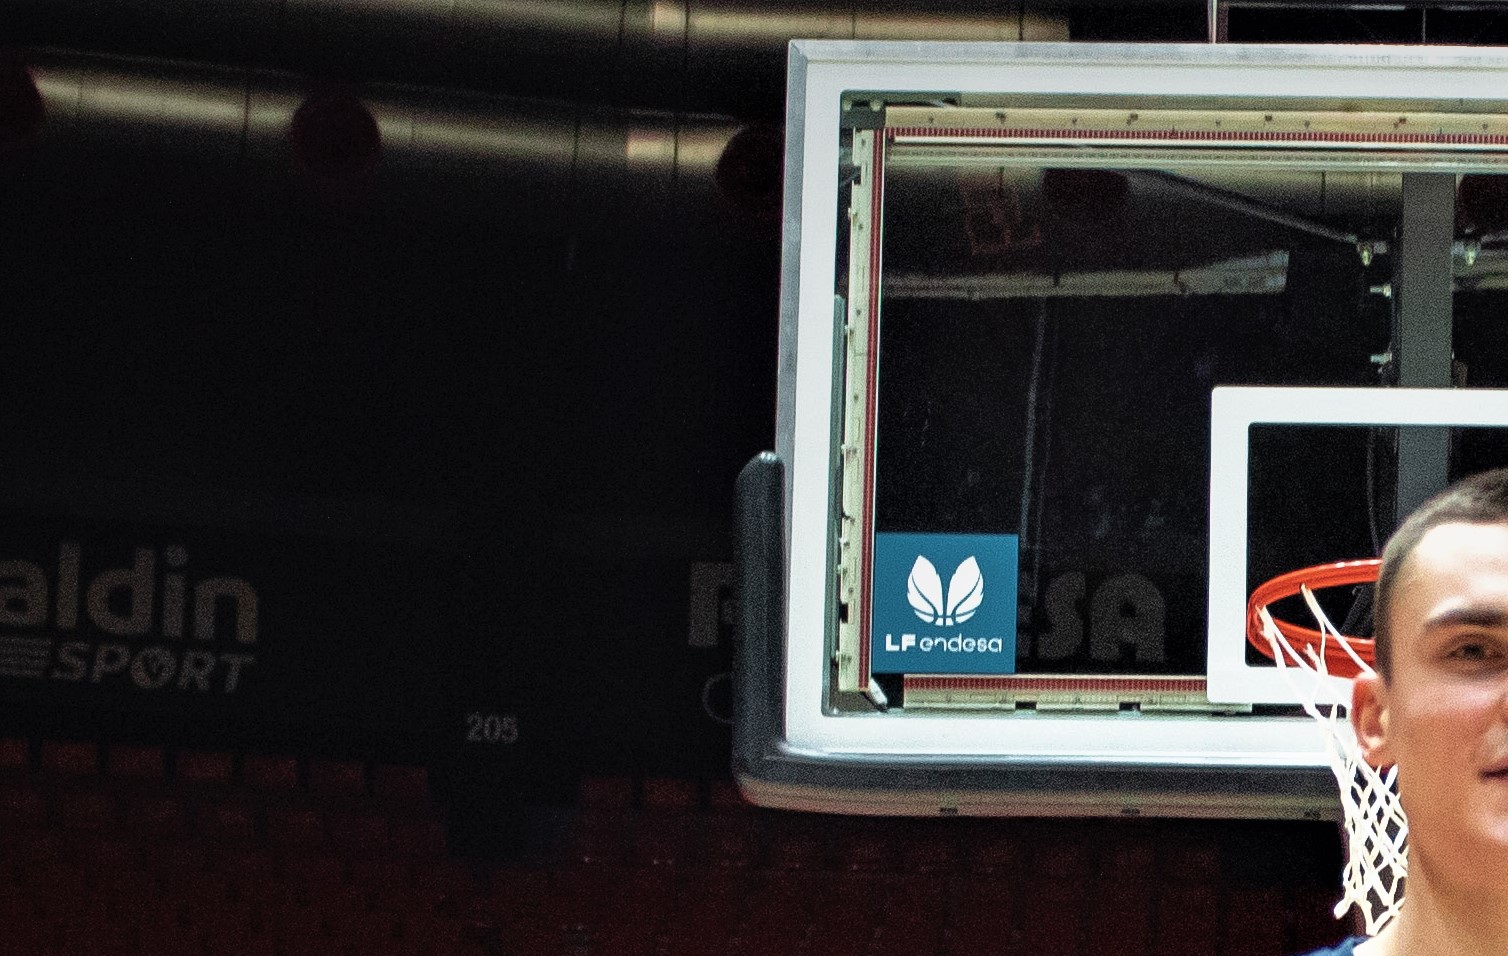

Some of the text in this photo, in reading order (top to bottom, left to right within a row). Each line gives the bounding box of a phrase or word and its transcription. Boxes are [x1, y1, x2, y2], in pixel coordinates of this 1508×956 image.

[885, 633, 1003, 654] LF endesa
[51, 640, 257, 693] SPORT
[466, 711, 520, 745] 205
